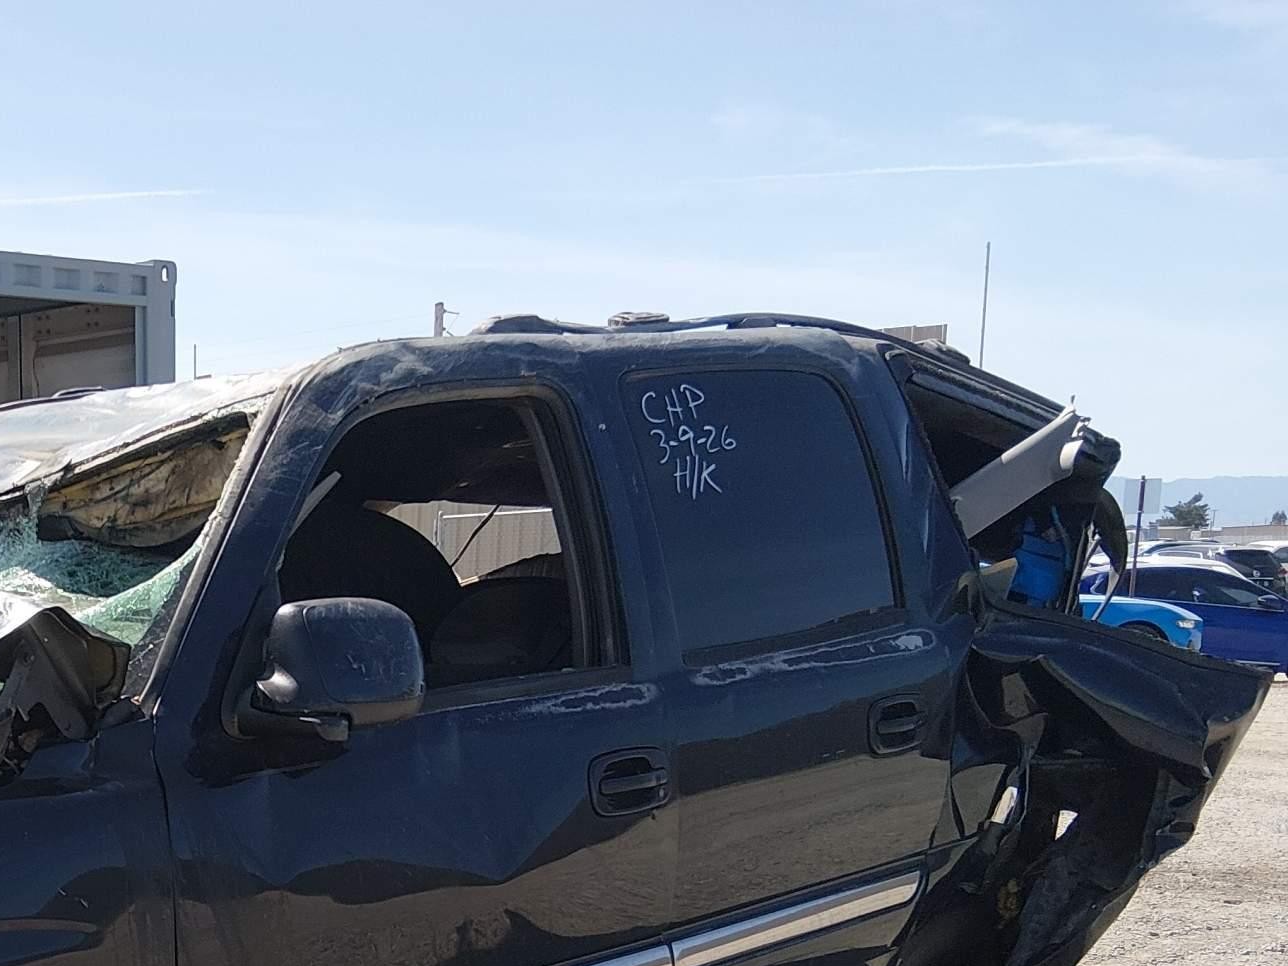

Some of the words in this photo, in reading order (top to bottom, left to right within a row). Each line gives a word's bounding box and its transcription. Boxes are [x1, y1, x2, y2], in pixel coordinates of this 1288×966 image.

[641, 384, 705, 427] CHP
[650, 425, 737, 464] 3-9-26
[673, 454, 723, 500] H/K
